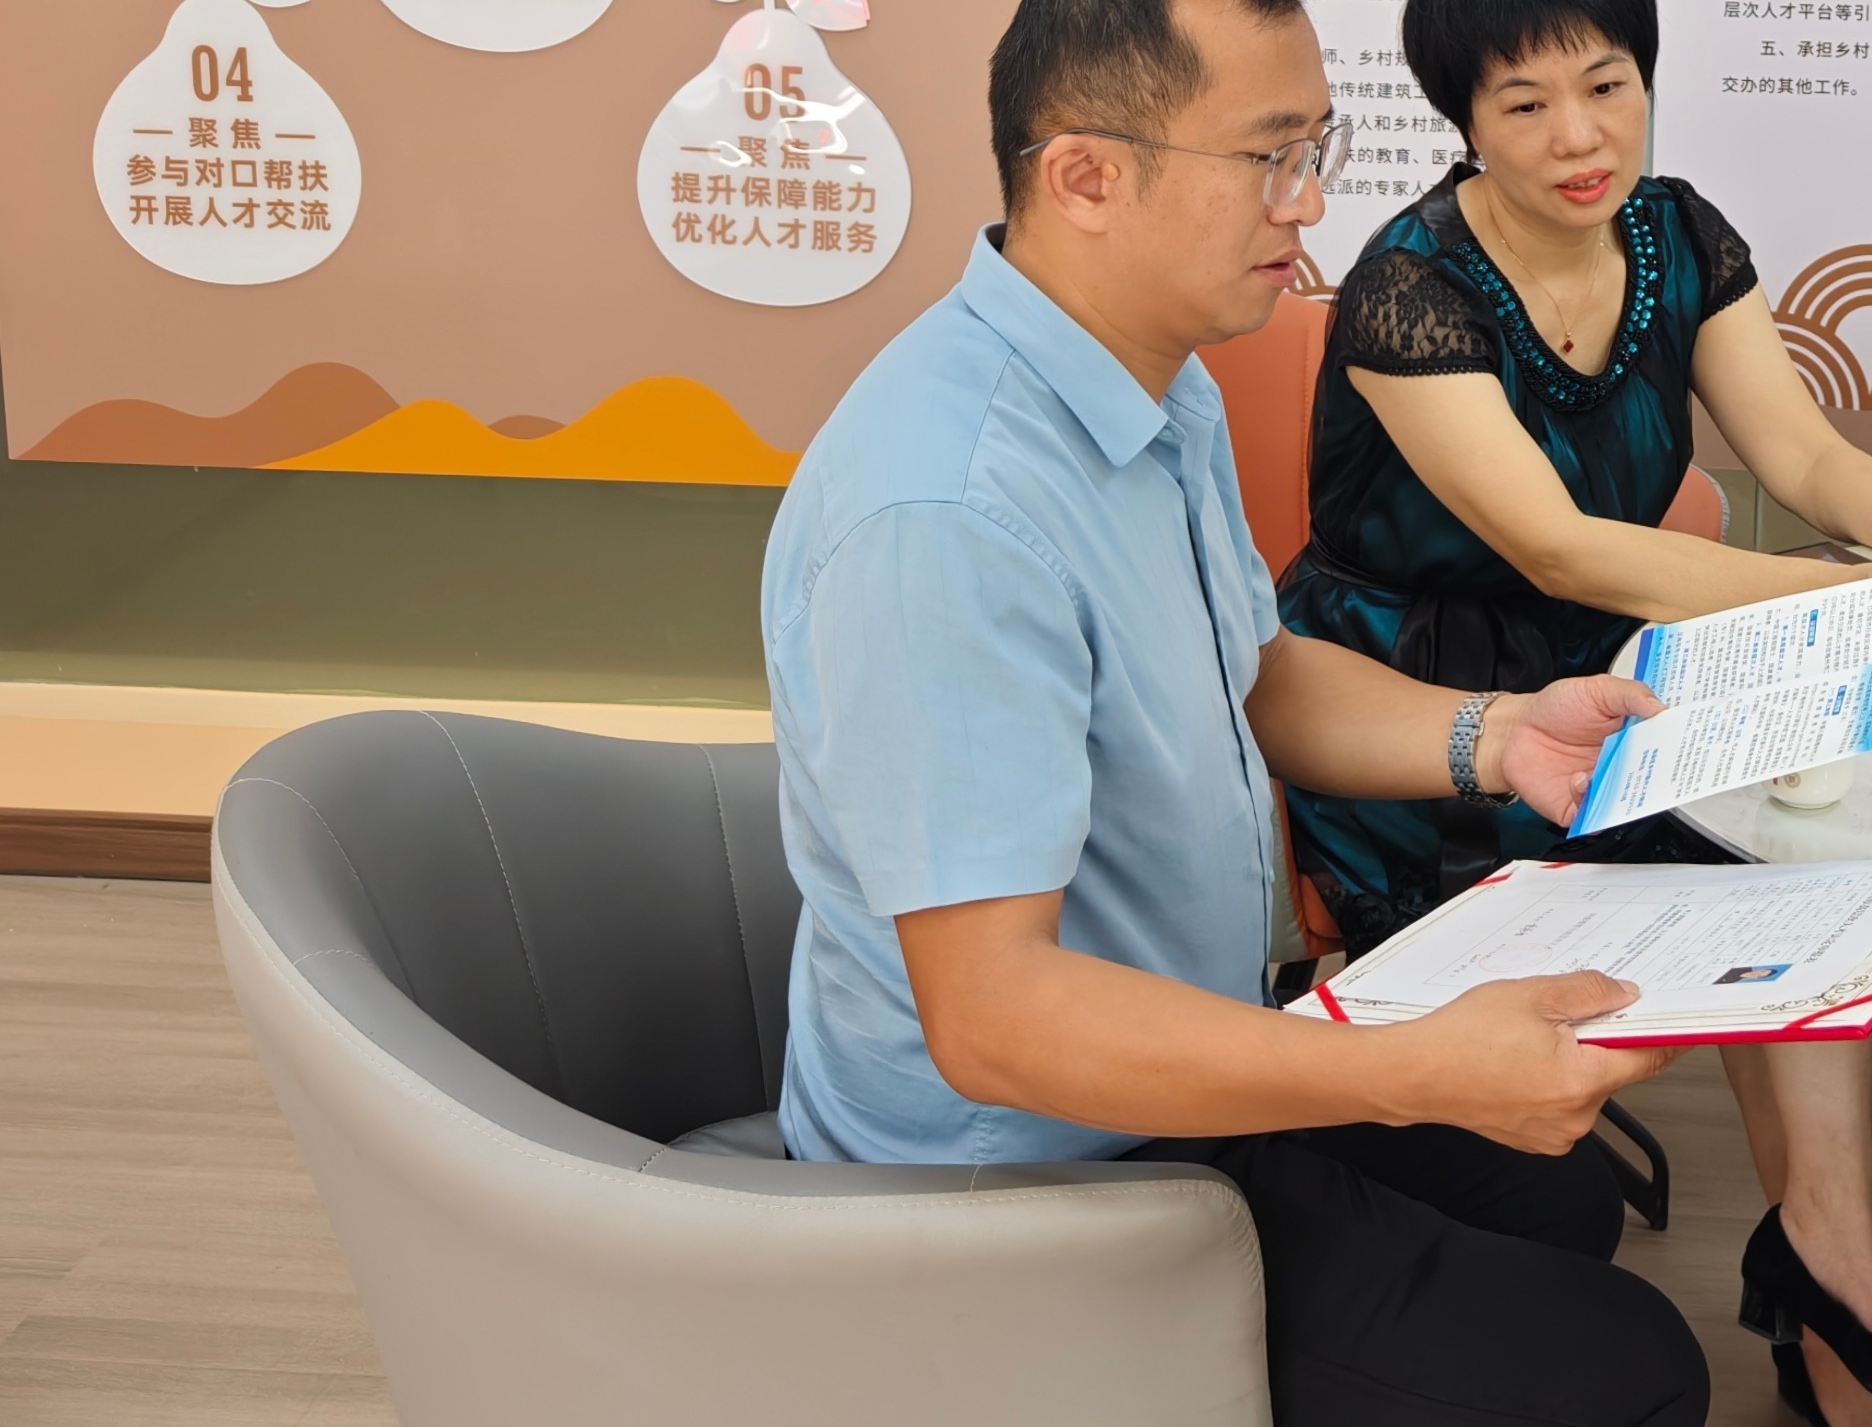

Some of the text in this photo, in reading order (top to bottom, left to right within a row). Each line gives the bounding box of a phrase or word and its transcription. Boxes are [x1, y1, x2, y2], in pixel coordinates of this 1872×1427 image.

[192, 45, 253, 102] 04
[1722, 76, 1857, 96] 交办的其他工作。
[743, 63, 807, 122] 05
[189, 117, 261, 149] 聚焦
[127, 154, 329, 191] 参与对口帮扶
[738, 136, 812, 173] 聚焦
[671, 172, 875, 215] 提升保障能力
[129, 195, 331, 231] 开展人才交流
[672, 212, 877, 253] 优化人才服务
